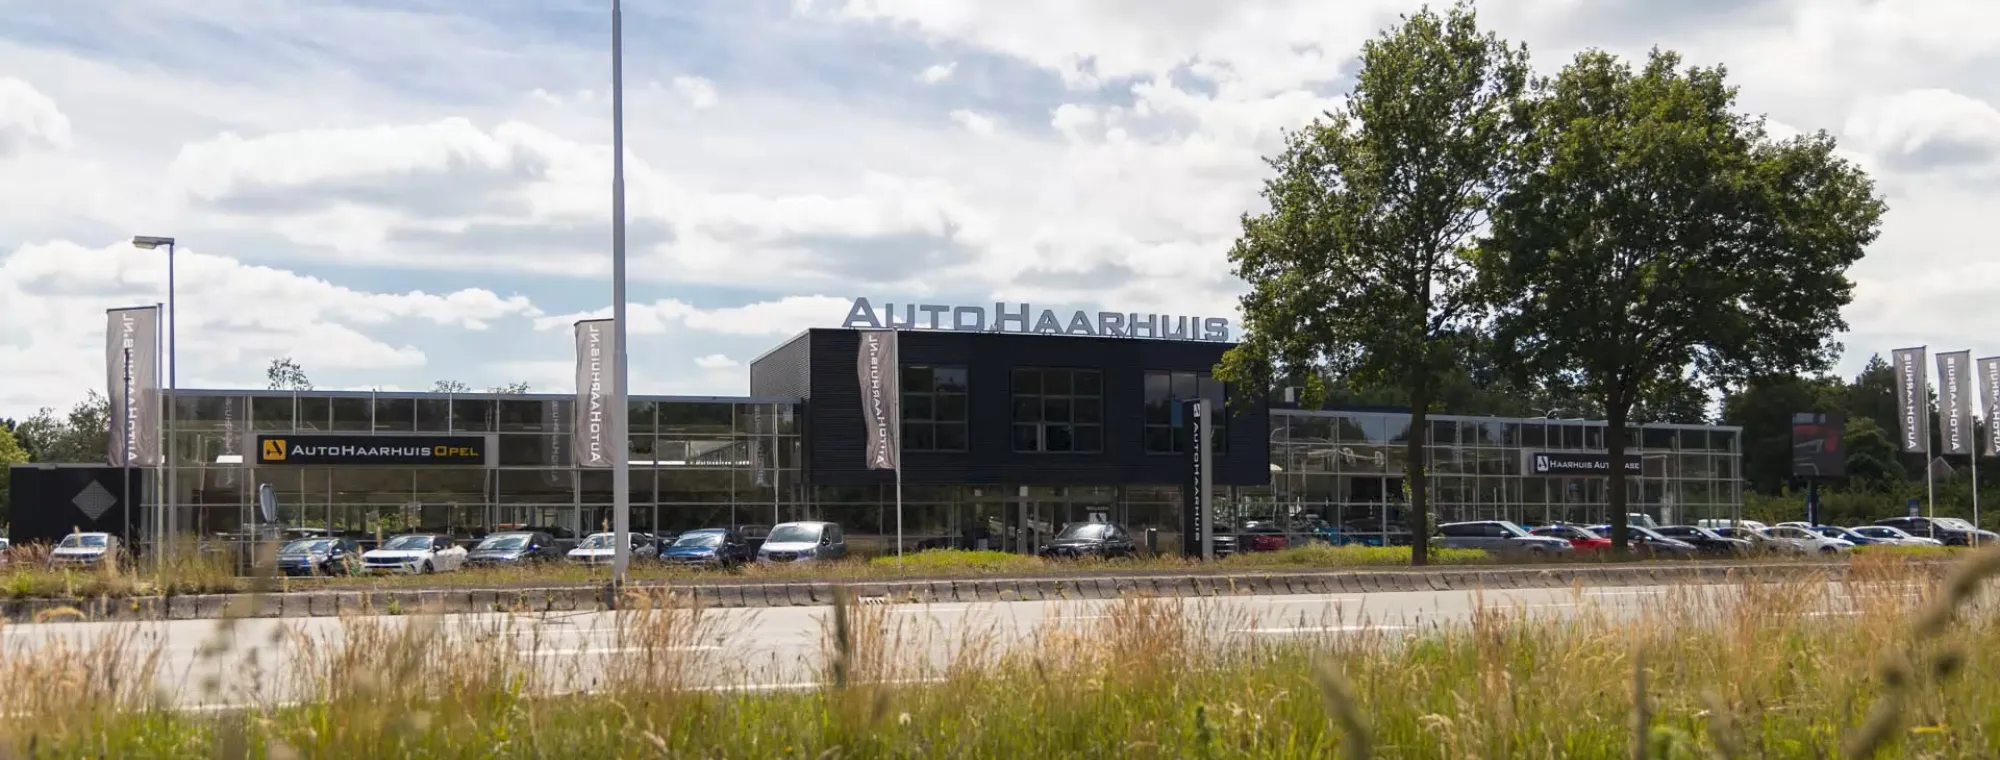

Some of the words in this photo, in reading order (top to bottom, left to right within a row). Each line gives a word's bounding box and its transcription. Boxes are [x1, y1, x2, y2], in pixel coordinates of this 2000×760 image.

[842, 297, 1229, 342] AUTOHAARHUIS
[291, 444, 431, 457] AUTOHAARHUIS
[434, 445, 479, 457] OPEL
[1549, 460, 1593, 469] HAARHUIS
[1594, 461, 1641, 469] AUTASE
